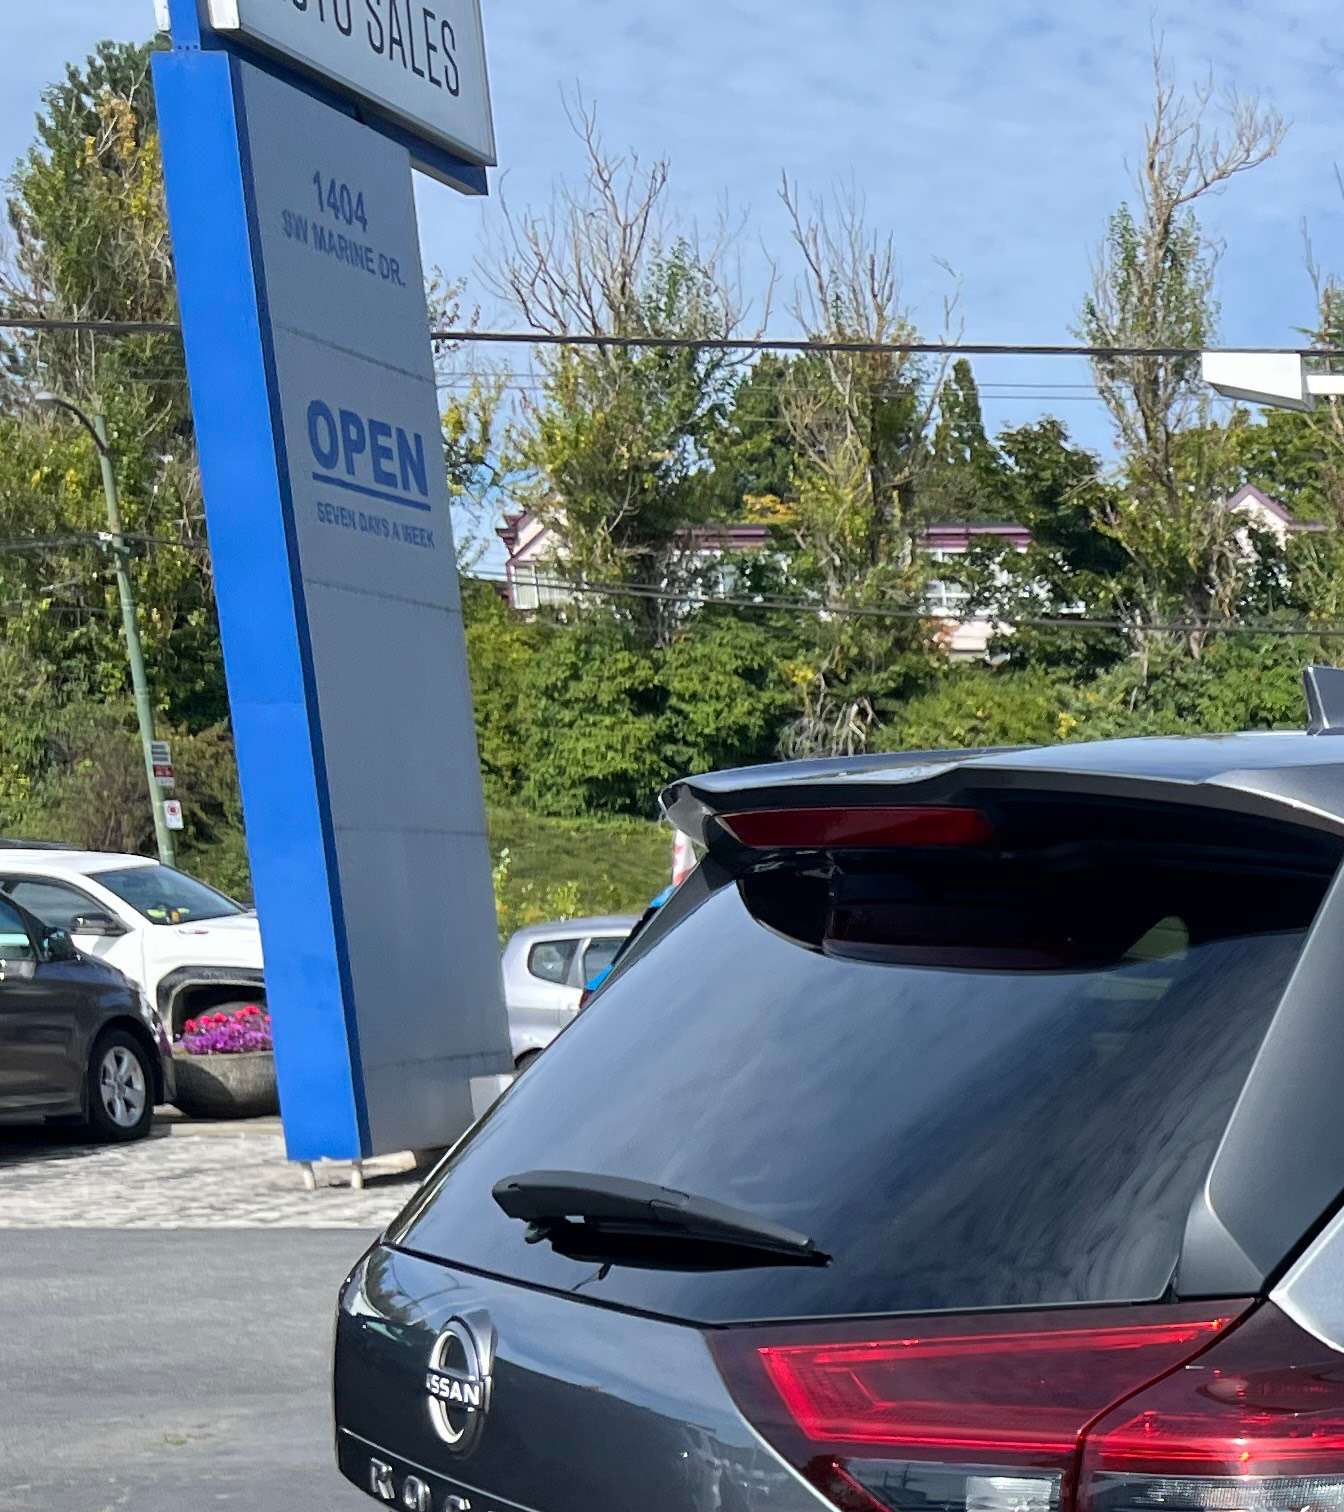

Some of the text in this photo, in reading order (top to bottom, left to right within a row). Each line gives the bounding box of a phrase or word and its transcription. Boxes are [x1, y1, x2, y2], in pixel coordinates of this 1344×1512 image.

[366, 0, 460, 97] SALES
[312, 170, 369, 232] 1404
[281, 208, 406, 288] SW MARINE DR.
[306, 399, 430, 497] OPEN
[316, 501, 356, 531] SEVEN
[358, 512, 391, 539] DAYS
[400, 523, 436, 549] WEEK
[425, 1372, 480, 1406] ISSAN
